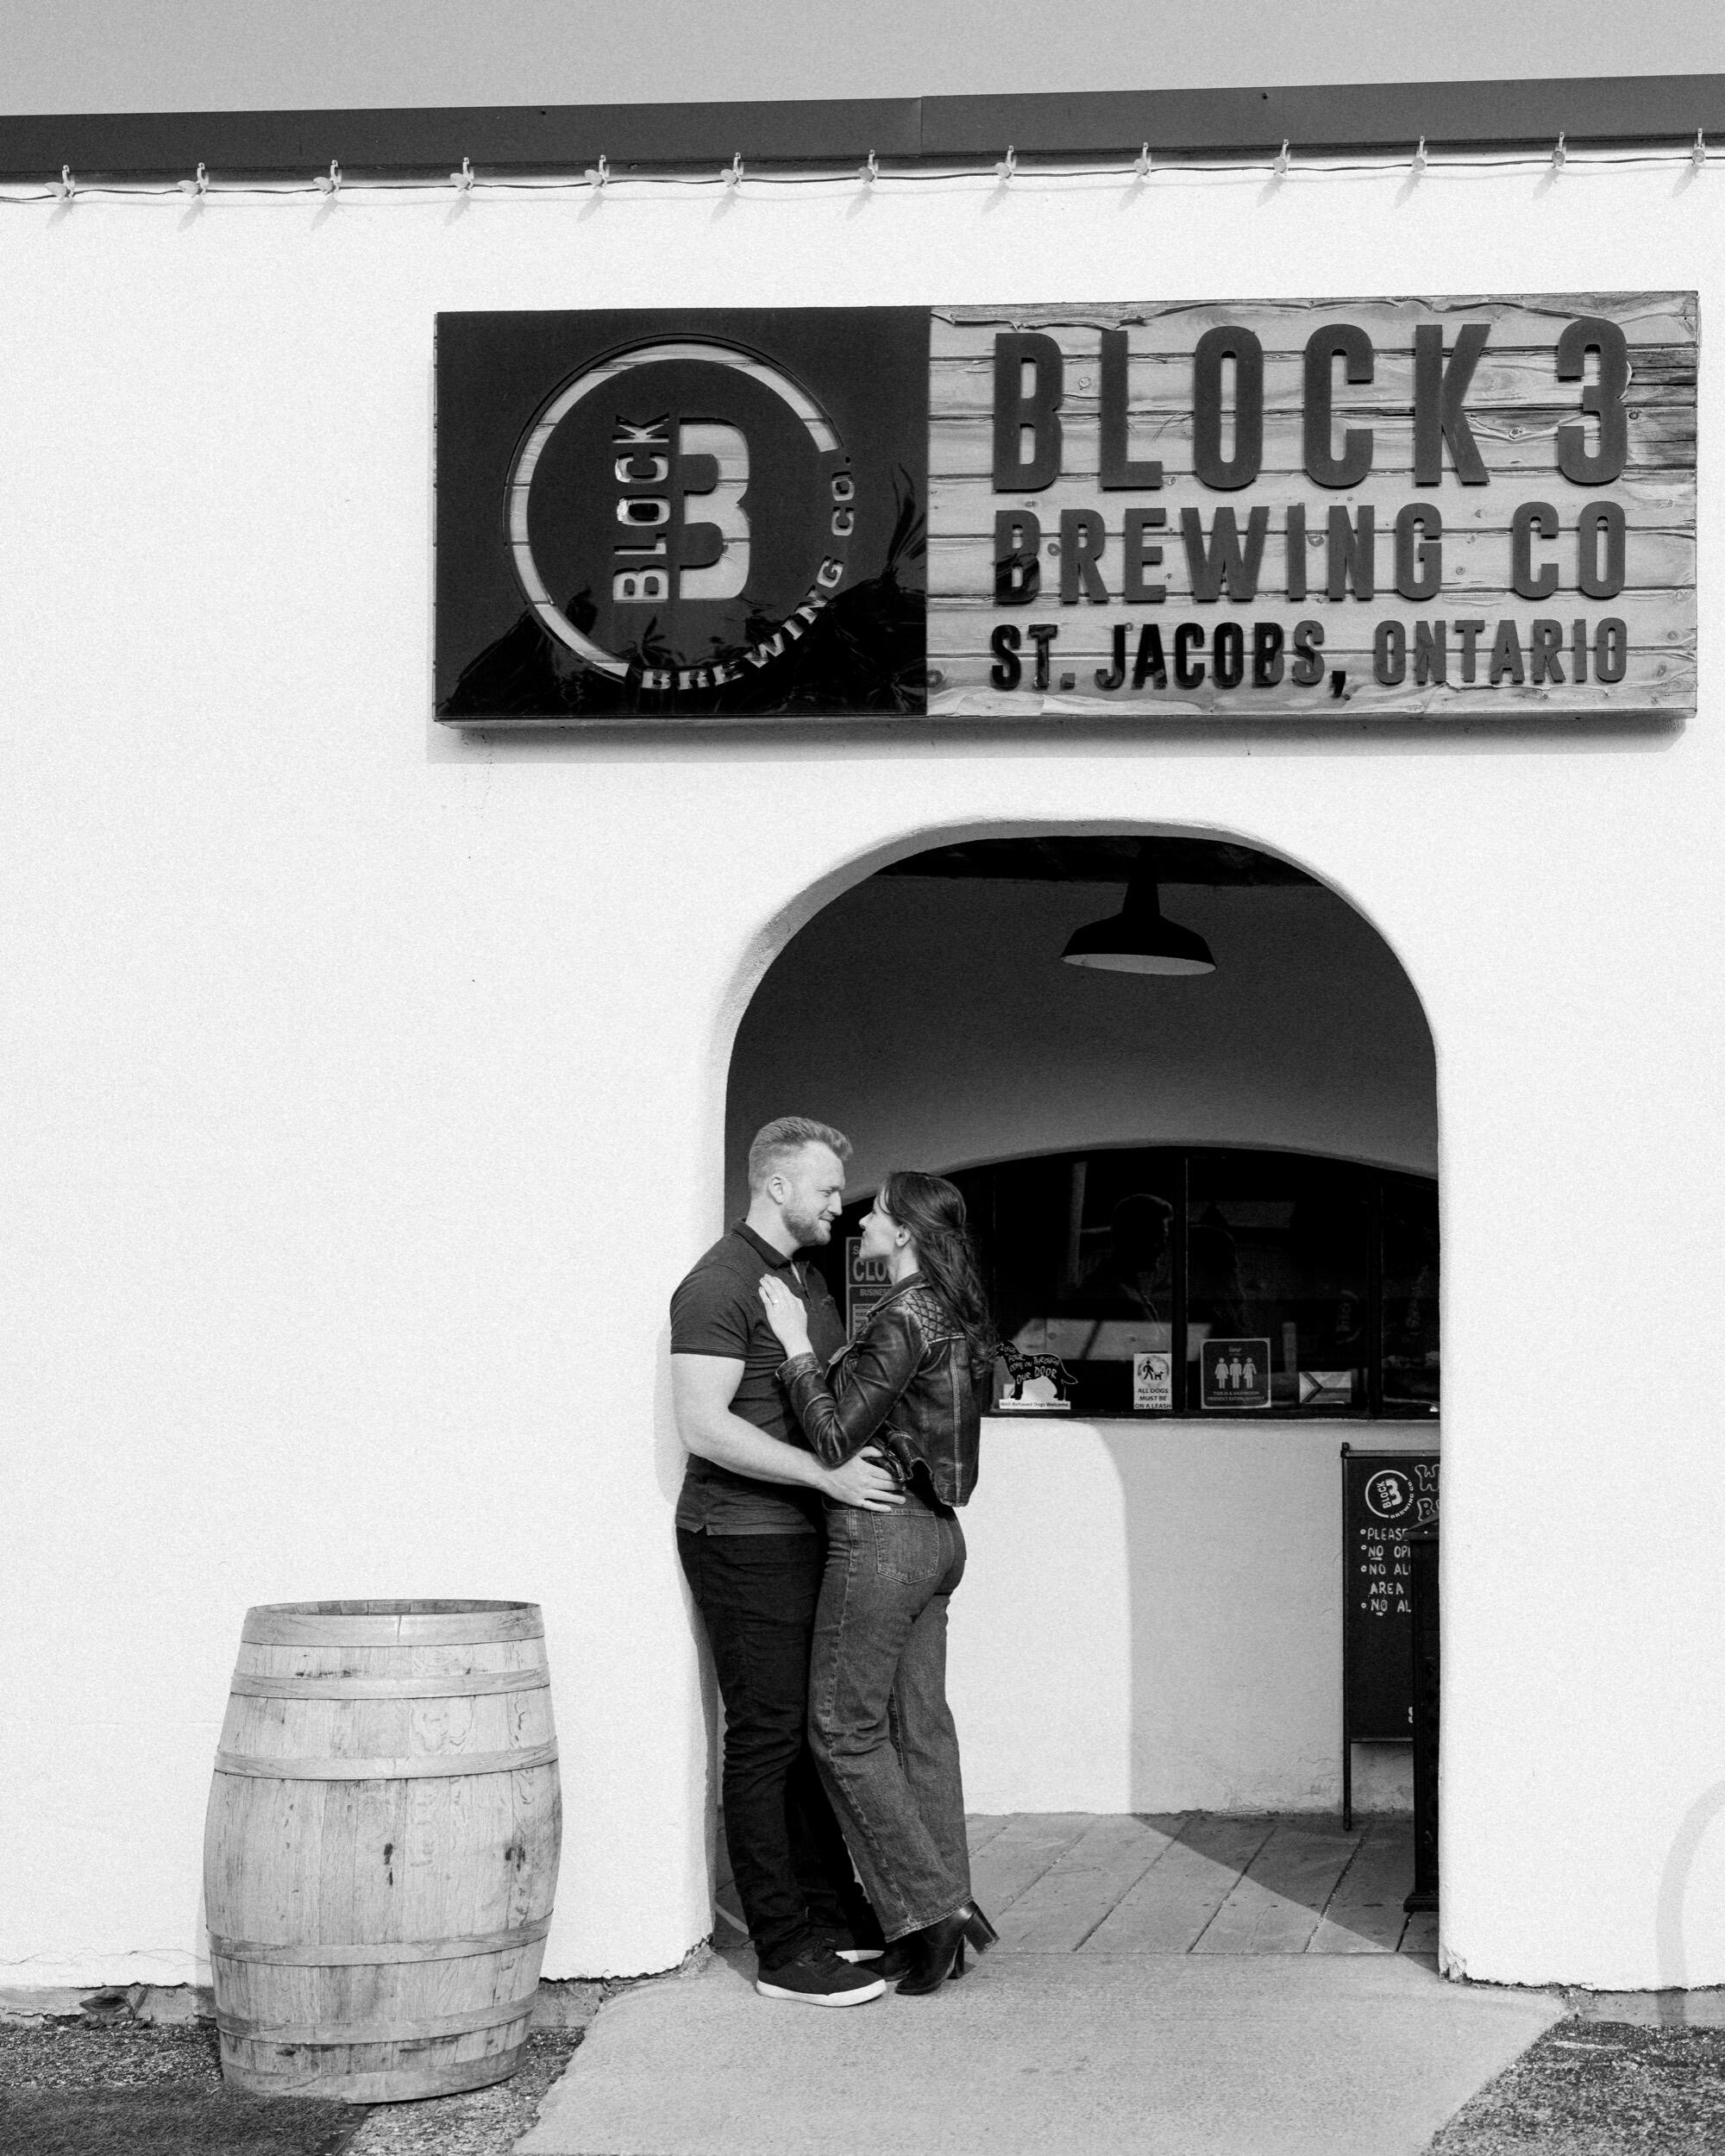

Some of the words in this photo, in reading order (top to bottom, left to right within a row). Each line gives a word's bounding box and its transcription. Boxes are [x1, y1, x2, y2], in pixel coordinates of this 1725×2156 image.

[993, 323, 1492, 492] BLOCK
[1557, 317, 1628, 486] 3
[612, 411, 670, 604] BLOCK
[679, 417, 750, 600] 3
[994, 501, 1442, 605] BREWING
[1512, 499, 1628, 601] CO
[642, 555, 845, 690] BREWING
[990, 623, 1076, 691] ST.
[1096, 618, 1348, 699] JACOBS,
[1378, 617, 1628, 687] ONTARIO
[1016, 1372, 1032, 1385] OUR
[1034, 1366, 1057, 1380] DOOR
[1376, 1481, 1392, 1509] BLOCK
[1385, 1478, 1402, 1506] 3
[1369, 1545, 1383, 1557] NO
[1394, 1545, 1411, 1558] OP
[1369, 1564, 1386, 1575] NO
[1394, 1564, 1411, 1576] AL
[1370, 1582, 1404, 1595] AREA
[1371, 1599, 1388, 1612] NO
